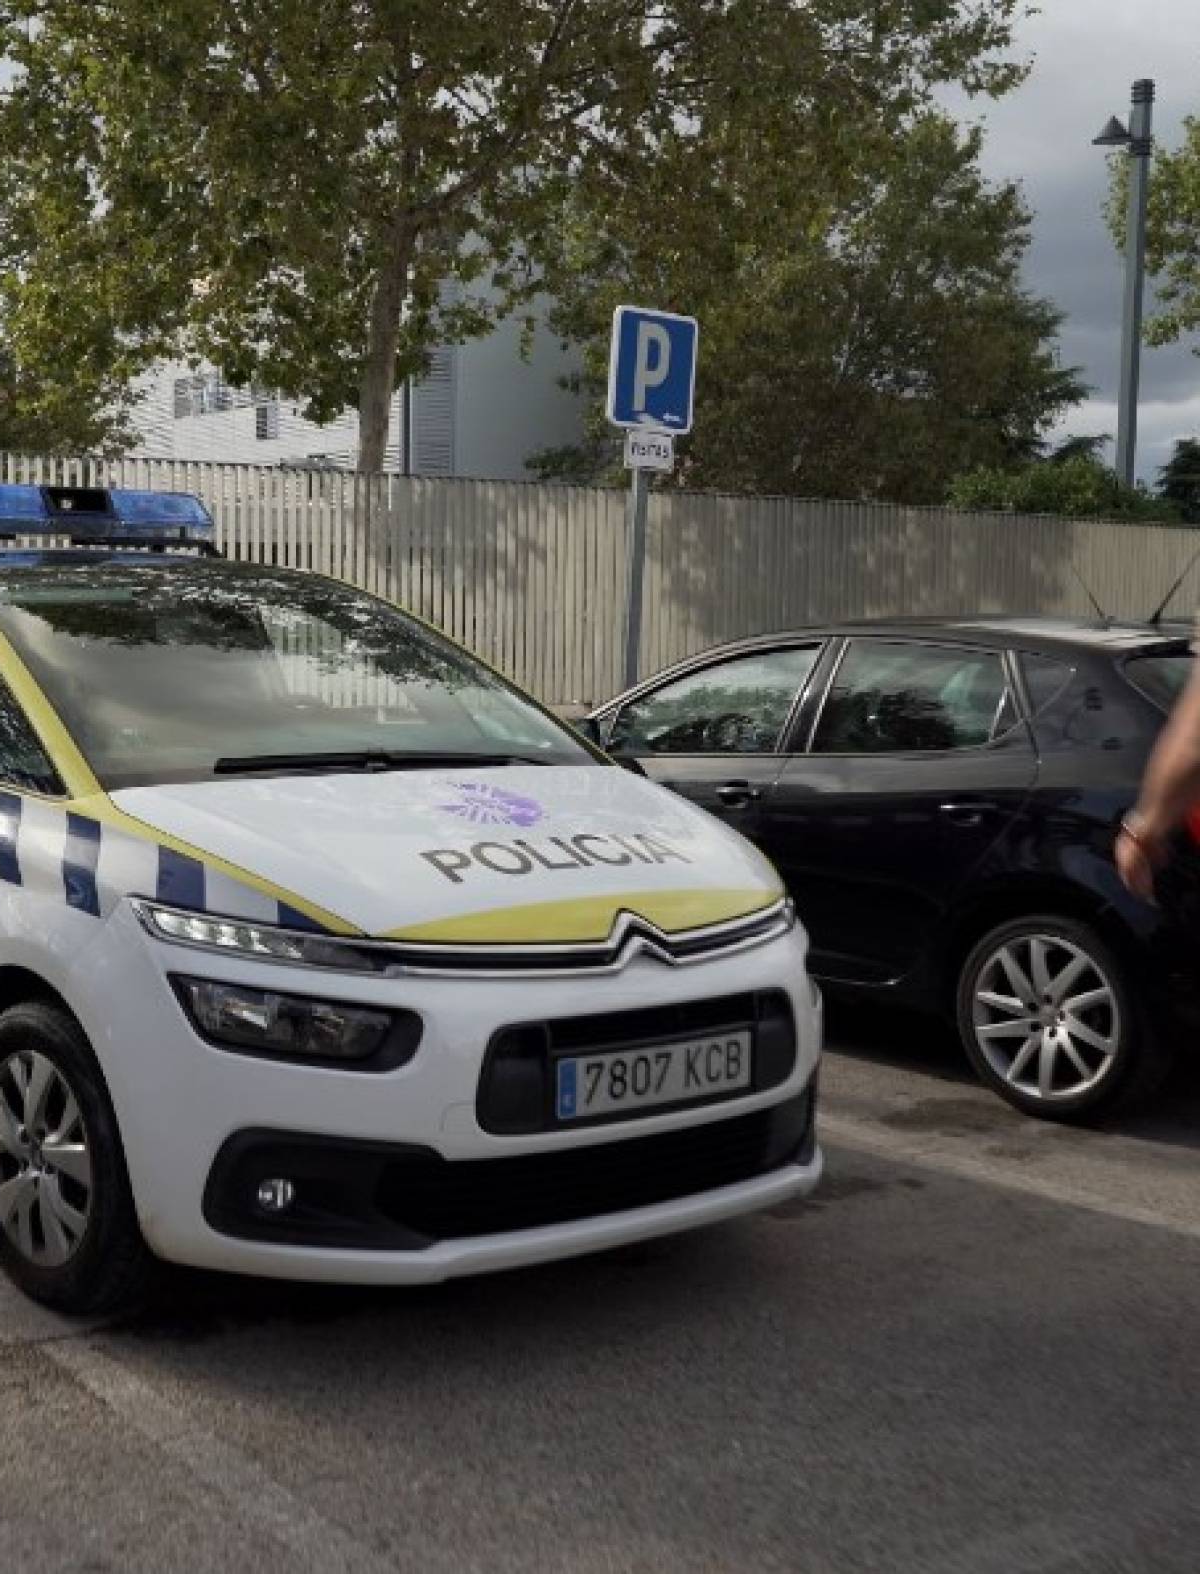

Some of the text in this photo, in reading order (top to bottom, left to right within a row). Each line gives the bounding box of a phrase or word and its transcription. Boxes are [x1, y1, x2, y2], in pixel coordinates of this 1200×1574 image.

[634, 321, 670, 410] P
[419, 832, 692, 883] POLICIA
[584, 1039, 741, 1107] 7807 KCB
